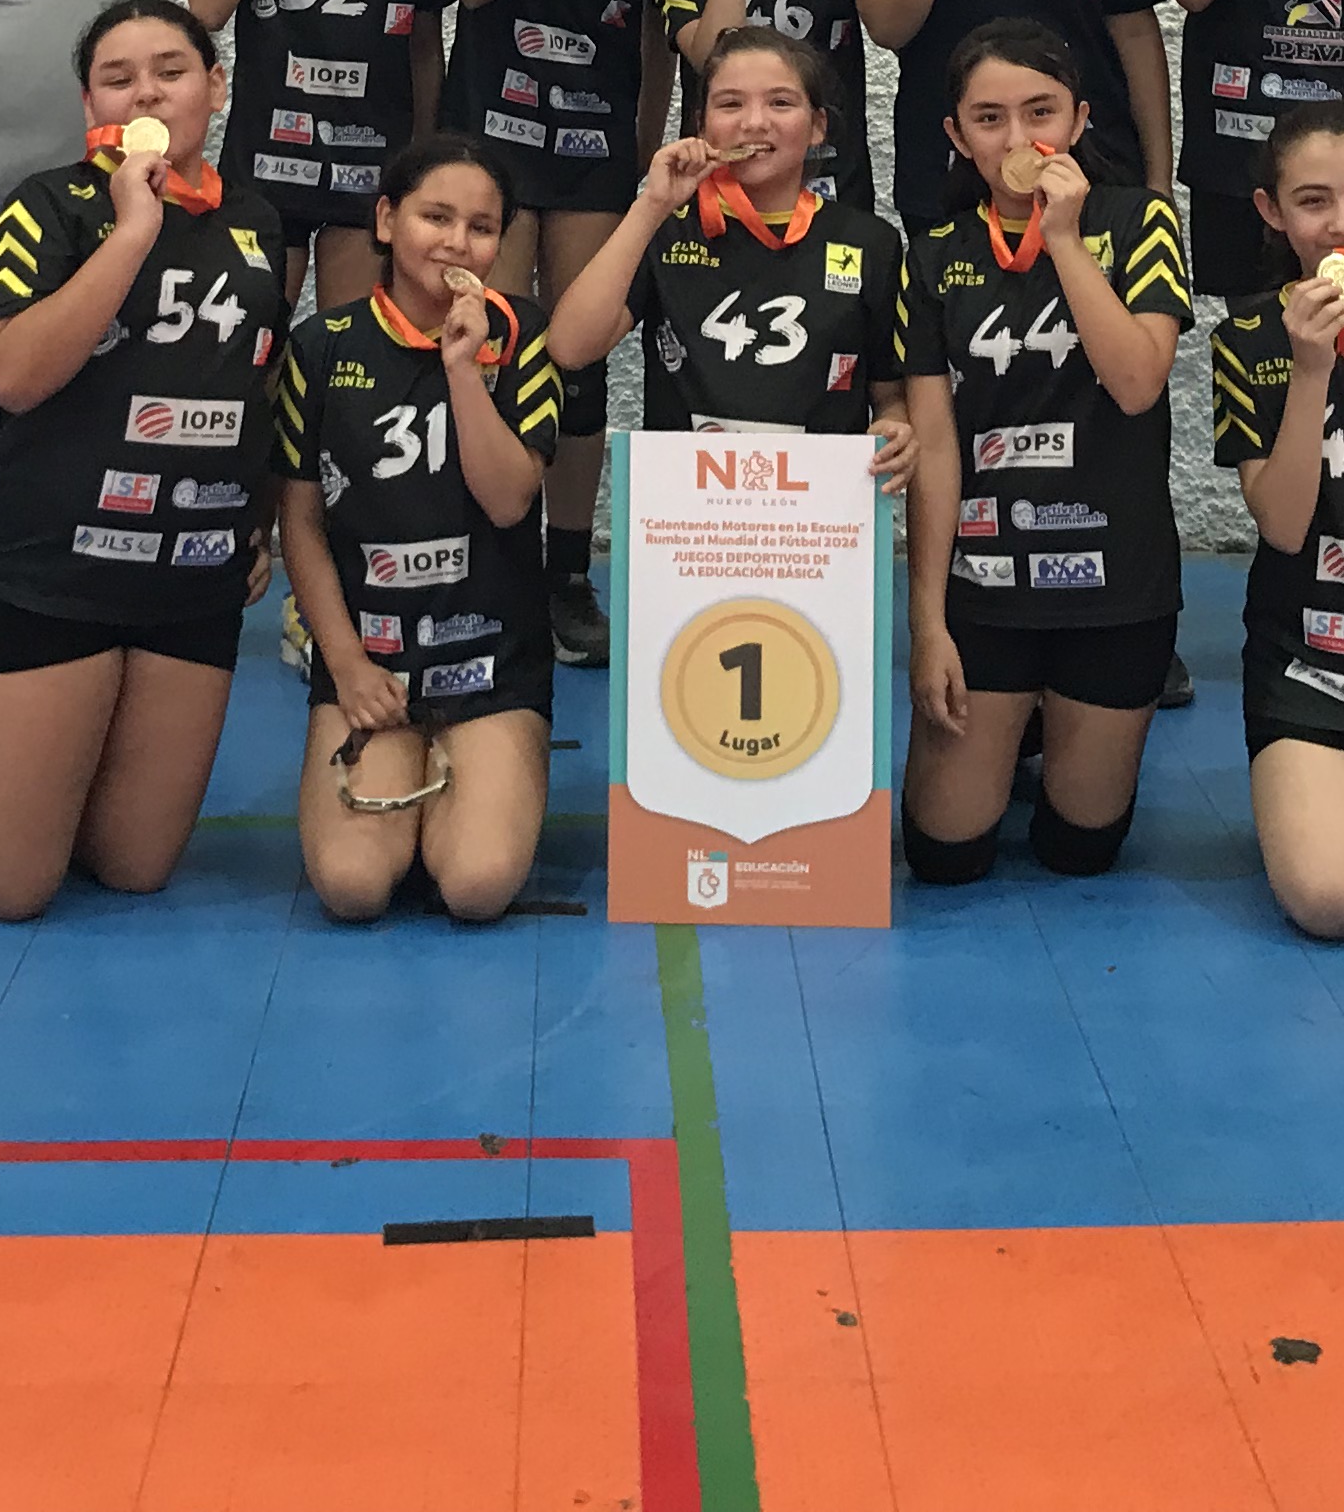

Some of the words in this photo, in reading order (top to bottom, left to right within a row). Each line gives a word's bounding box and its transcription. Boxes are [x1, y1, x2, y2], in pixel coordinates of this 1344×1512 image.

[548, 33, 590, 54] IOPS
[309, 66, 360, 85] IOPS
[283, 113, 307, 132] SF
[500, 120, 527, 136] JLS
[1230, 117, 1254, 132] JLS
[271, 161, 298, 176] JLS
[662, 252, 720, 268] LEONES
[146, 268, 248, 343] 54
[701, 290, 808, 365] 43
[969, 296, 1081, 376] 44
[1249, 372, 1291, 386] LEON
[180, 408, 237, 431] IOPS
[373, 401, 447, 479] 31
[1013, 432, 1065, 452] OPS
[117, 476, 150, 499] SF
[707, 498, 752, 506] NUEVO
[762, 496, 797, 506] LEÓN
[967, 500, 989, 521] SF
[722, 520, 776, 532] Motores
[778, 524, 794, 532] en
[796, 521, 808, 533] la
[97, 535, 134, 552] JLS
[645, 533, 690, 545] Rumbo
[693, 534, 704, 545] al
[707, 534, 758, 546] Mundial
[761, 535, 776, 546] de
[779, 534, 821, 547] Fútbol
[824, 537, 858, 548] 2026
[403, 547, 465, 573] IOPS
[672, 551, 723, 564] JUEGOS
[726, 552, 810, 565] DEPORTIVOS
[813, 554, 830, 565] DE
[678, 566, 695, 577] LA
[698, 564, 774, 579] EDUCACIÓN
[776, 565, 824, 579] BÁSICA
[370, 617, 392, 637] SF
[1315, 614, 1343, 636] SF
[719, 643, 762, 721] 1
[719, 729, 781, 756] Lugar
[734, 860, 810, 874] EDUCACIÓN
